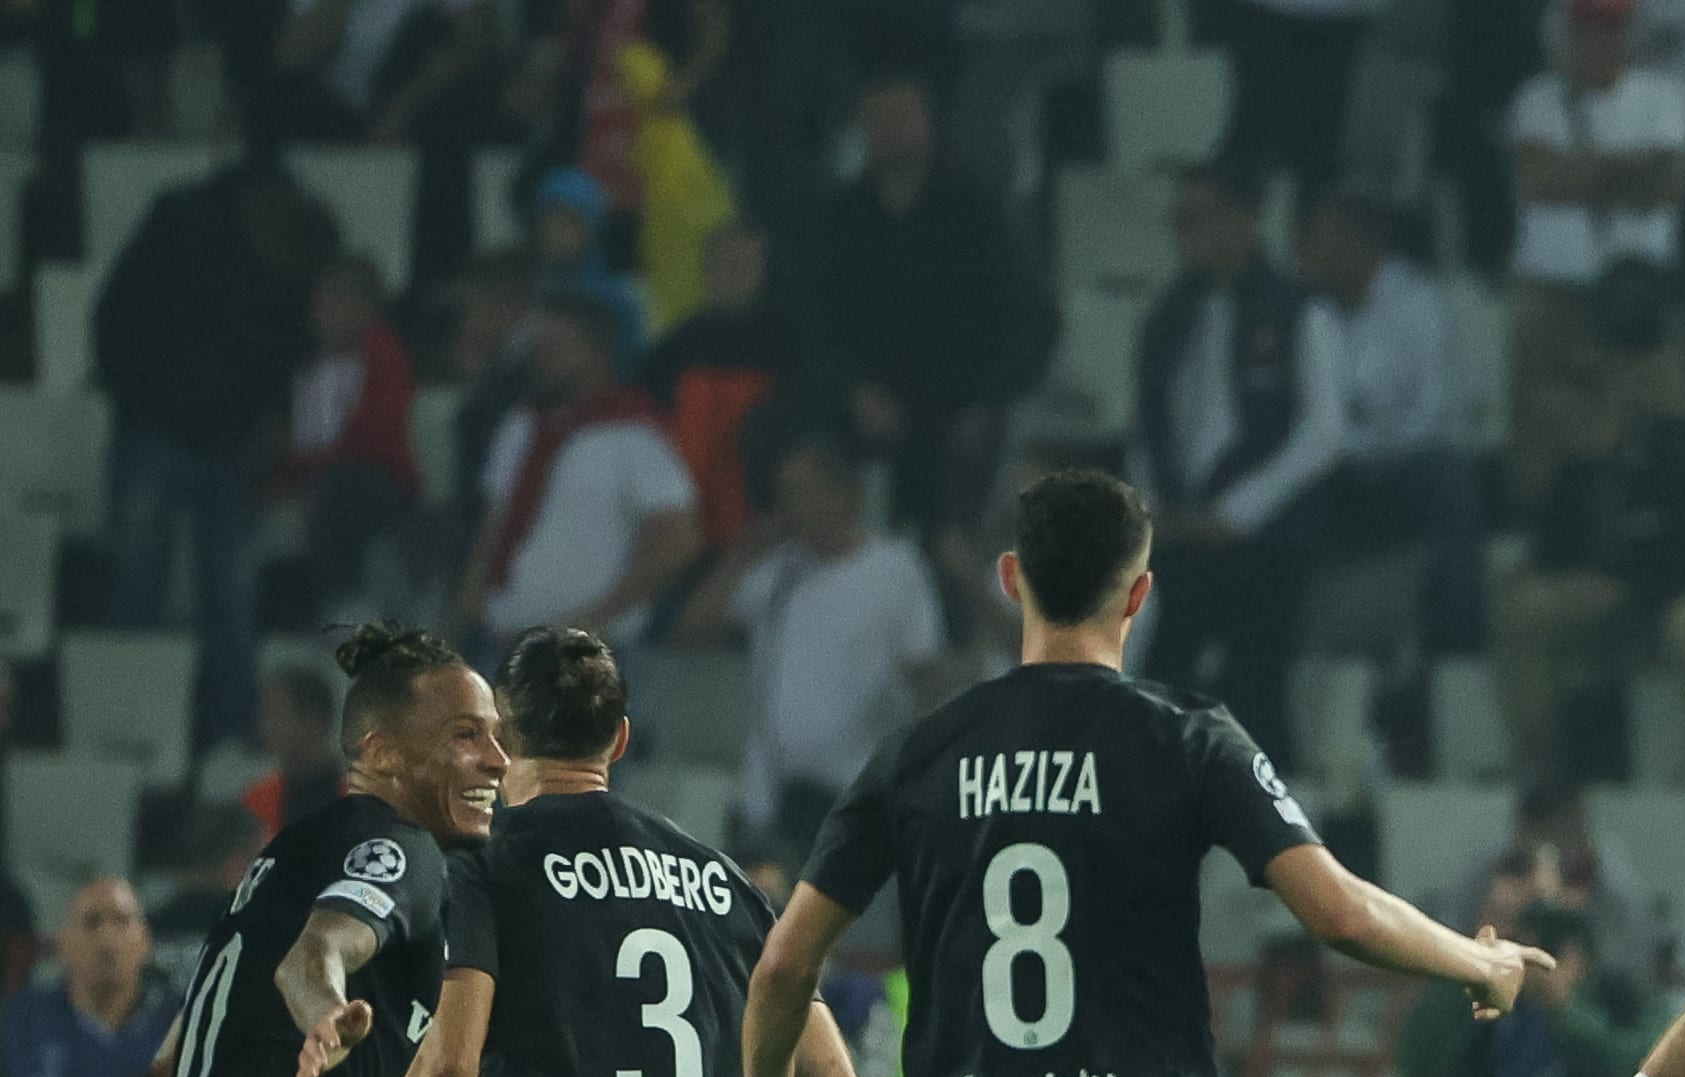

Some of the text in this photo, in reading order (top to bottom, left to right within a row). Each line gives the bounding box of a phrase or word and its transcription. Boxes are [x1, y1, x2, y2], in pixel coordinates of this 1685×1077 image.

[959, 750, 1102, 819] HAZIZA
[544, 846, 732, 915] GOLDBERG
[981, 842, 1075, 1050] 8
